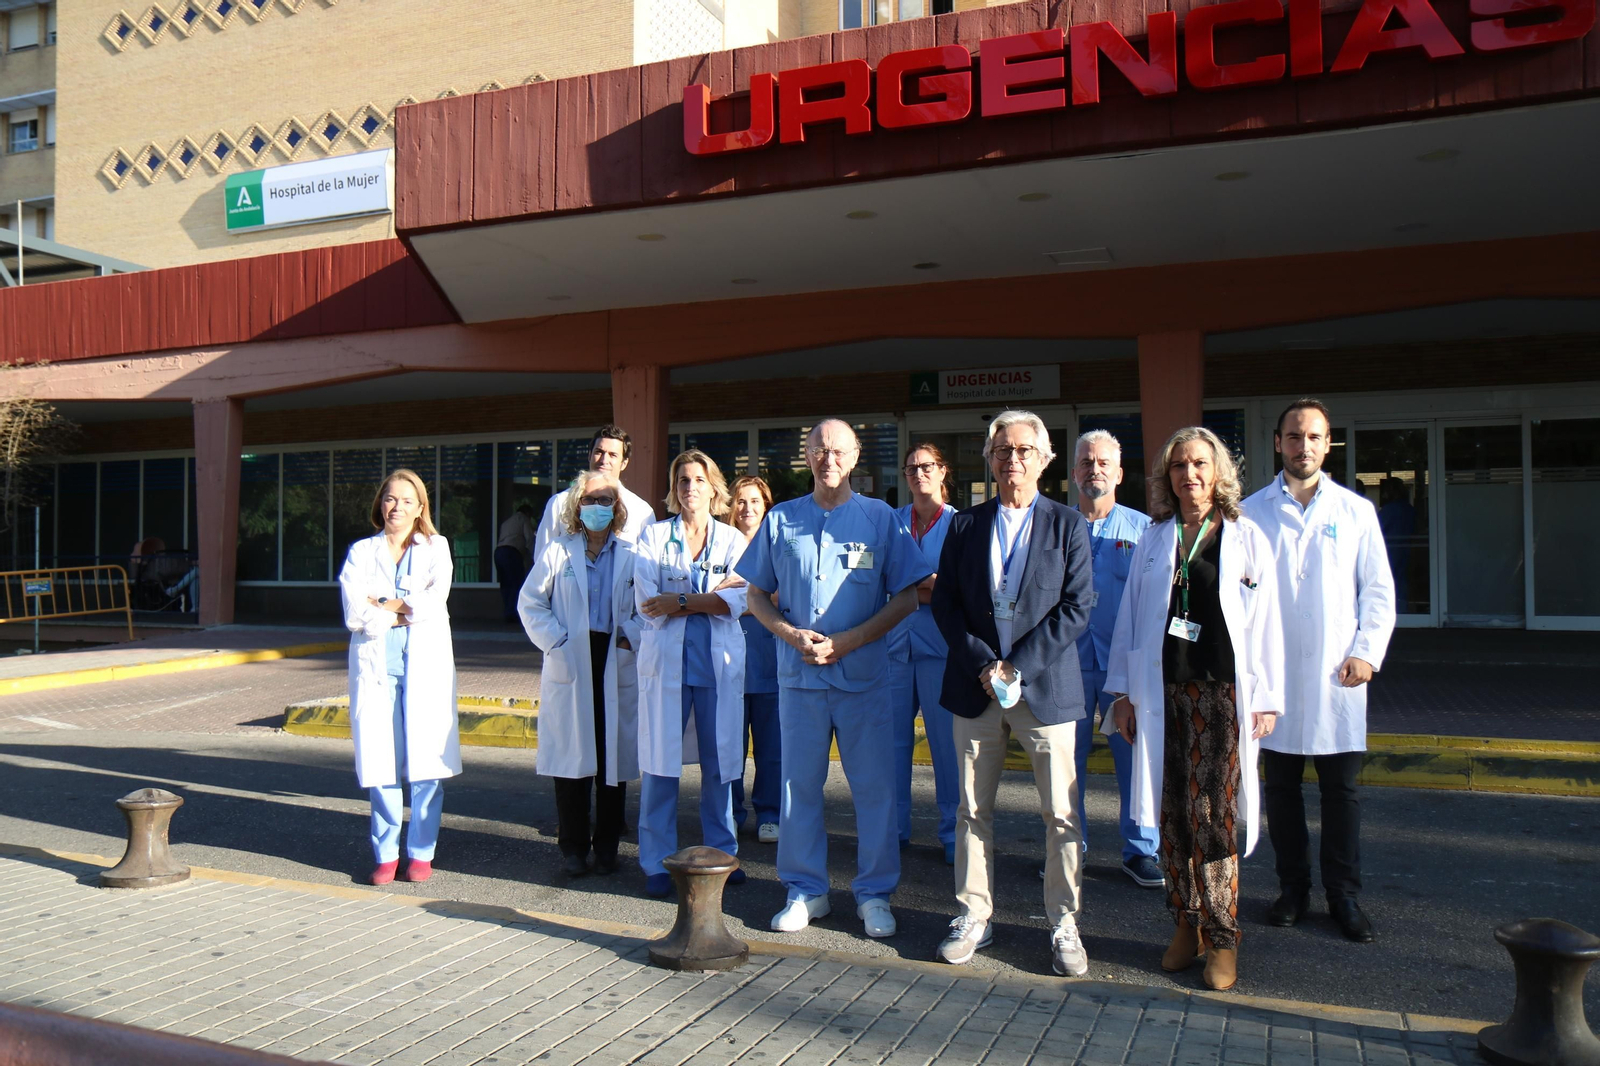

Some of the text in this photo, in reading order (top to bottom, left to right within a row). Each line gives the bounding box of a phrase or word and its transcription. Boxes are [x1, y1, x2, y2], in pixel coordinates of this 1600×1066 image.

[683, 0, 1596, 155] URGENCIAS
[269, 173, 379, 199] Hospital de la Mujer
[946, 371, 1032, 387] URGENCIAS
[947, 388, 983, 399] Hospital
[985, 388, 997, 397] de
[998, 387, 1007, 397] la
[1008, 386, 1033, 397] Mujer
